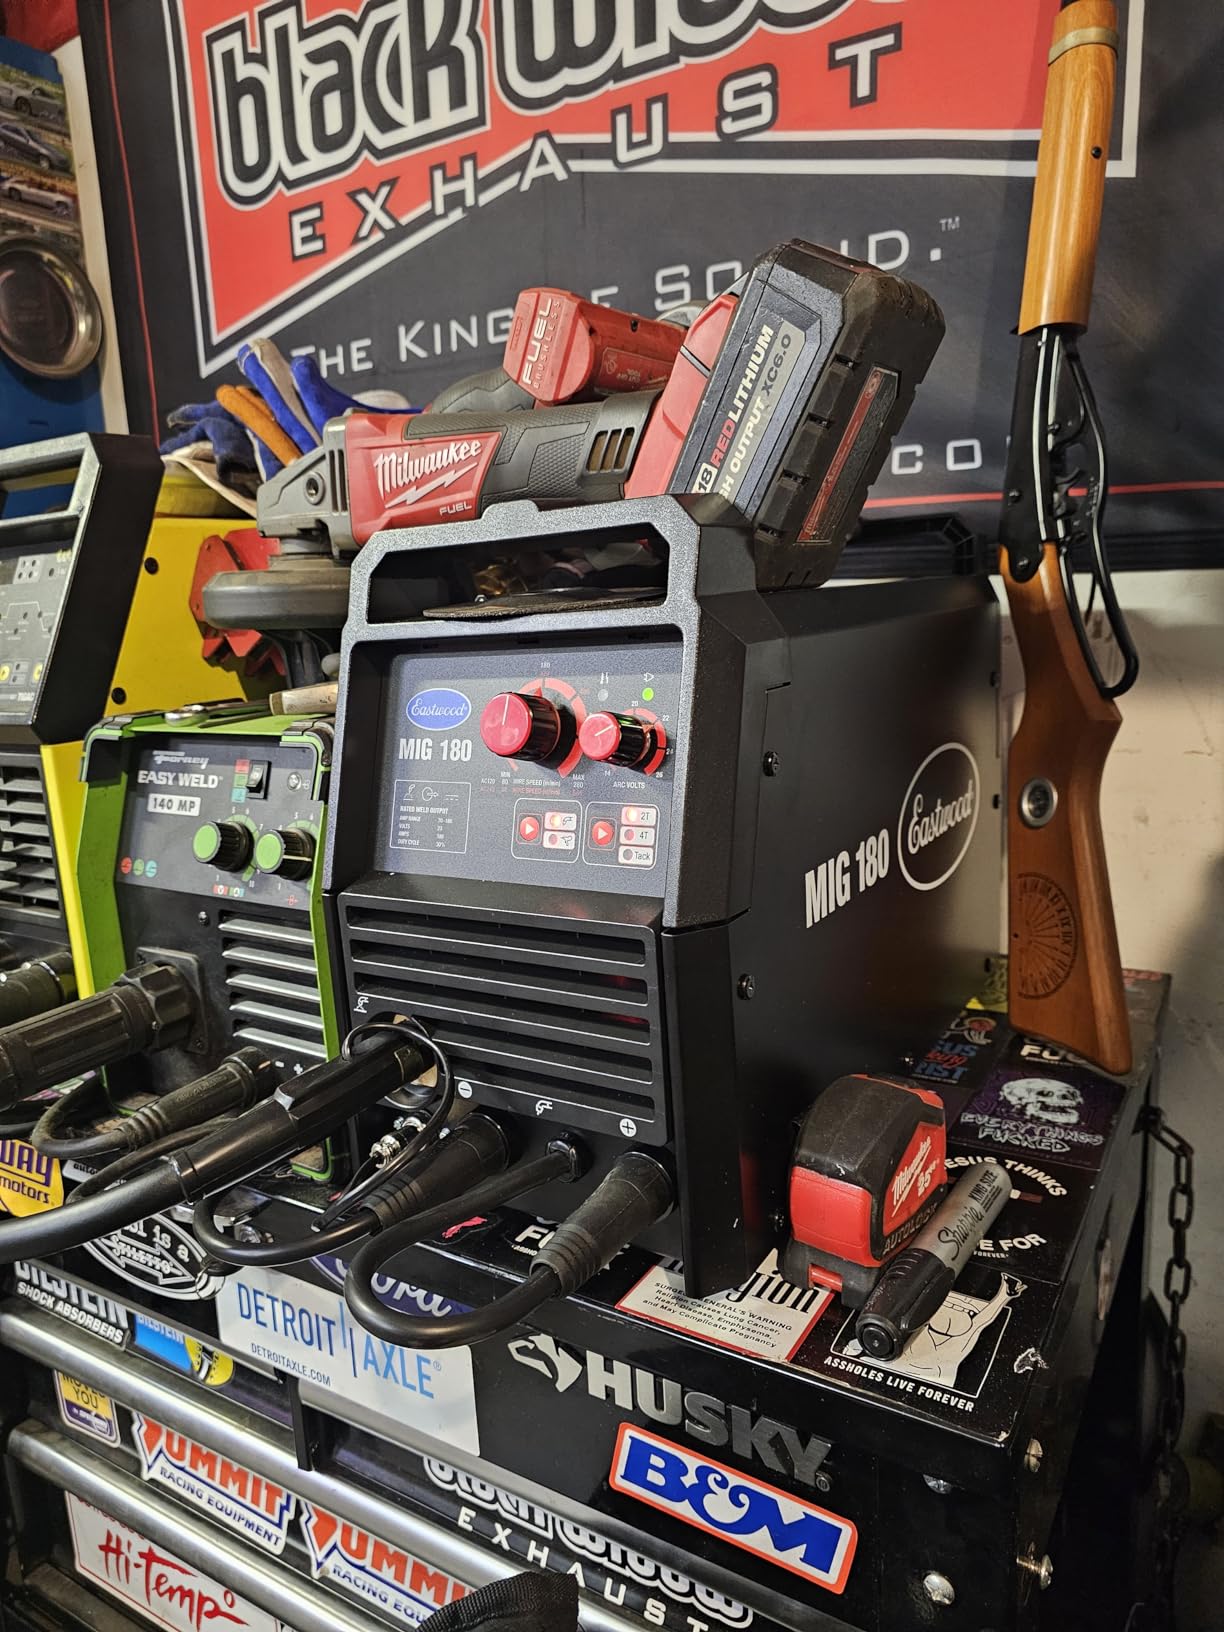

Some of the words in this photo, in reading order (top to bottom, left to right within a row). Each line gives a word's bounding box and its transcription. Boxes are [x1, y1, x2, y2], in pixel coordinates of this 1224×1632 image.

[208, 0, 488, 204] black
[290, 22, 902, 261] EXHAUST
[398, 307, 515, 364] KING
[655, 230, 941, 313] SOD.
[522, 298, 553, 385] FUEL
[533, 299, 561, 389] BRUSHLESS
[710, 323, 775, 469] REDLITHIUM
[730, 395, 767, 475] OUTPUT
[761, 332, 792, 396] XC6.0
[373, 438, 483, 499] Milwaukee
[438, 502, 473, 517] FUEL
[410, 697, 467, 716] Eastwood
[398, 737, 433, 761] MIG
[439, 738, 473, 762] 180
[137, 770, 178, 786] EASY
[178, 772, 220, 789] WELD
[572, 773, 585, 781] MAX
[612, 780, 627, 788] ARC
[626, 781, 646, 789] VOLTS
[152, 797, 174, 811] 140
[176, 798, 196, 812] MP
[640, 811, 651, 821] 2T
[907, 778, 974, 855] Eastwood
[634, 850, 651, 861] Tack
[639, 831, 649, 840] 4T
[804, 849, 851, 929] MIG
[854, 828, 890, 893] 180
[977, 1125, 1071, 1153] FUCKED
[944, 1155, 998, 1170] ESUS
[1004, 1159, 1068, 1197] THINKS
[967, 1183, 988, 1204] KING
[978, 1169, 998, 1188] SIZE
[176, 1243, 190, 1264] a
[937, 1204, 985, 1262] Sharpie
[998, 1233, 1048, 1252] FOR
[16, 1281, 55, 1310] SHOCK
[54, 1300, 124, 1345] ABSORBERS
[642, 1298, 660, 1309] and
[659, 1303, 679, 1317] May
[678, 1308, 728, 1332] Complicate
[728, 1327, 778, 1349] Pregnancy
[654, 1295, 679, 1311] Heart
[678, 1302, 715, 1322] Disease,
[716, 1314, 774, 1341] Emphysema,
[655, 1288, 691, 1306] Religion
[691, 1299, 722, 1316] Causes
[722, 1310, 746, 1327] Lung
[746, 1316, 782, 1337] Cancer,
[702, 1297, 748, 1317] ENERAL'S
[748, 1312, 793, 1333] WARNING
[236, 1282, 337, 1357] DETROIT
[361, 1336, 434, 1400] AXLE
[250, 1341, 333, 1388] DETROITAXLE.COM
[72, 1385, 99, 1410] YOU
[823, 1354, 884, 1384] ASSHOLES
[885, 1375, 917, 1396] LIVE
[916, 1384, 976, 1414] FOREVER
[585, 1349, 833, 1492] HUSKY
[159, 1466, 205, 1503] RACING
[206, 1497, 283, 1548] EQUIPMENT
[619, 1434, 844, 1575] B&M
[332, 1563, 390, 1605] RACING
[392, 1600, 426, 1625] EQU
